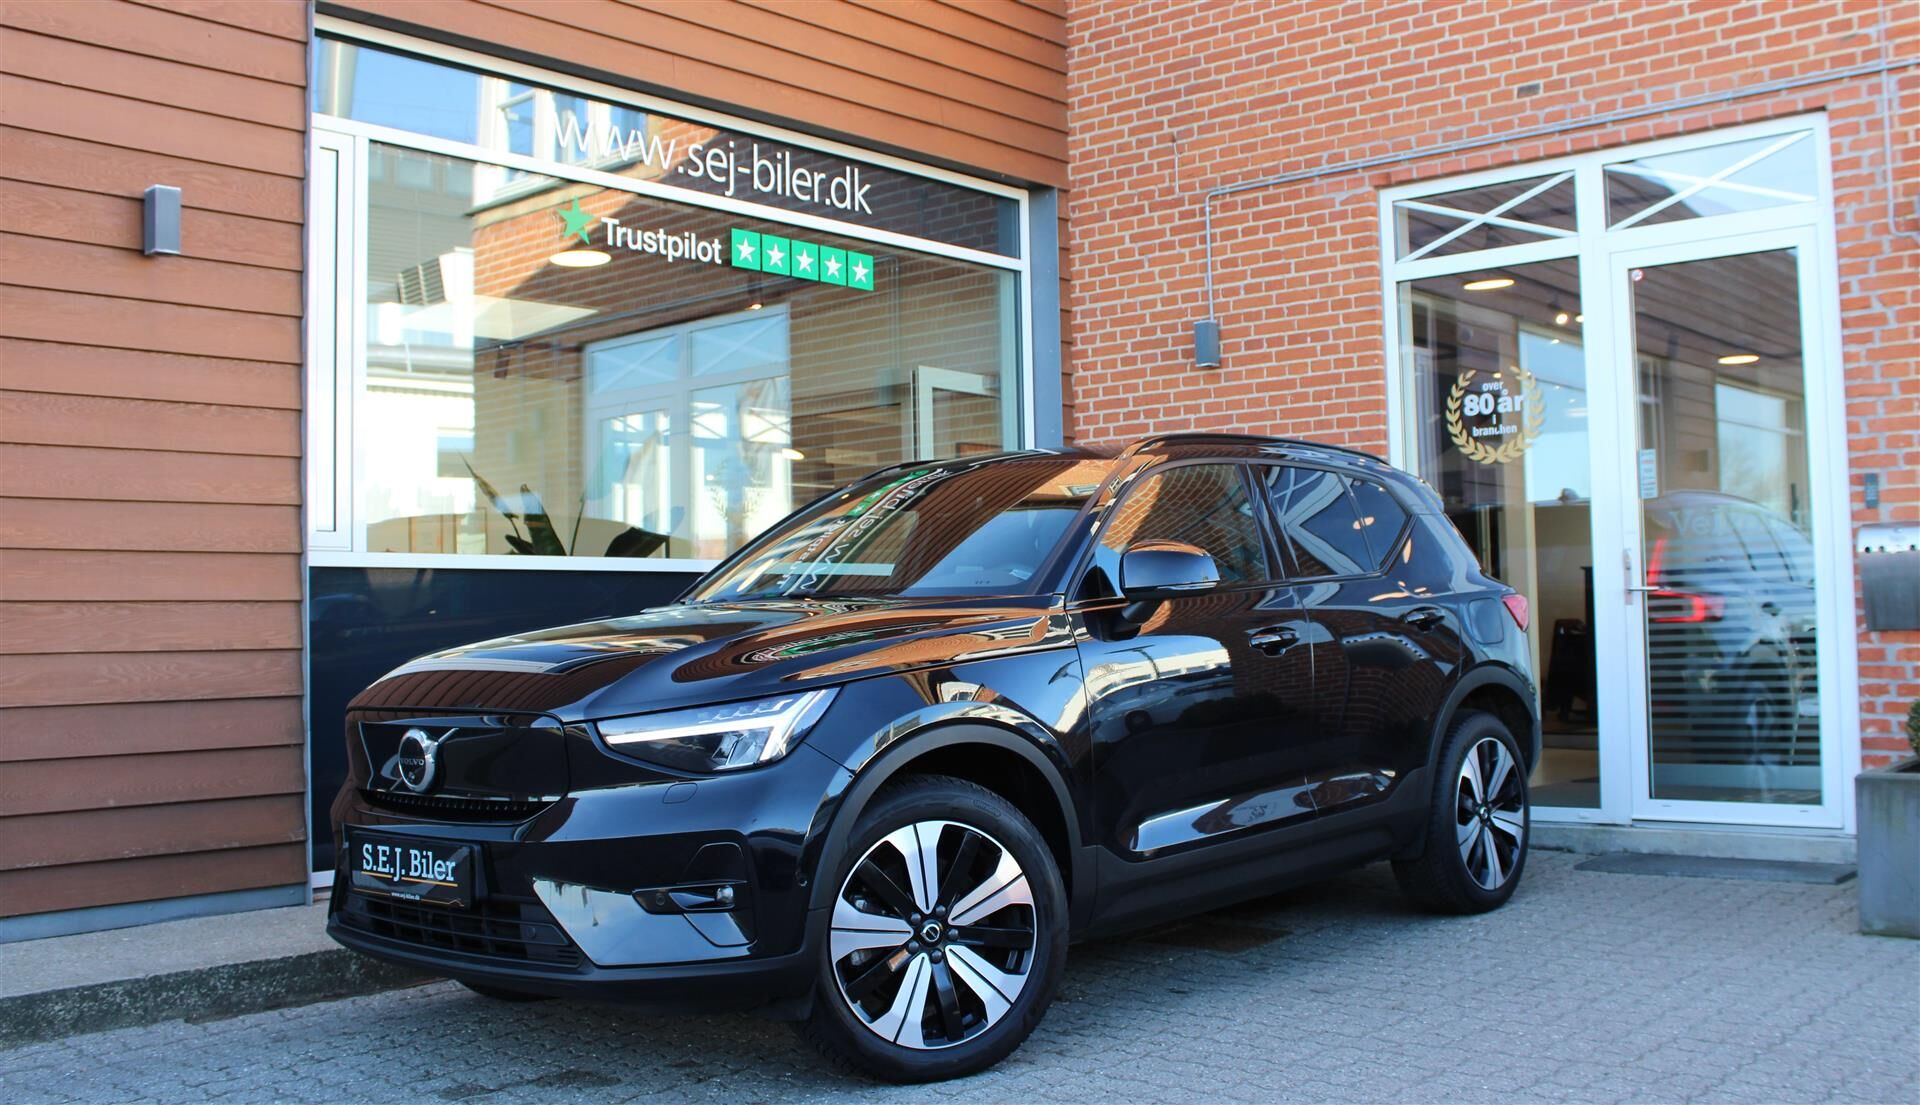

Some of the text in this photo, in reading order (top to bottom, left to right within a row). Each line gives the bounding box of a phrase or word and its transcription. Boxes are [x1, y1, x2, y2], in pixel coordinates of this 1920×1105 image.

[553, 112, 872, 215] www.sej-biler.dk
[600, 216, 722, 264] Trustpilot
[1463, 389, 1525, 416] 80 år
[1482, 381, 1504, 391] over
[362, 843, 456, 882] S.E.J. Biler
